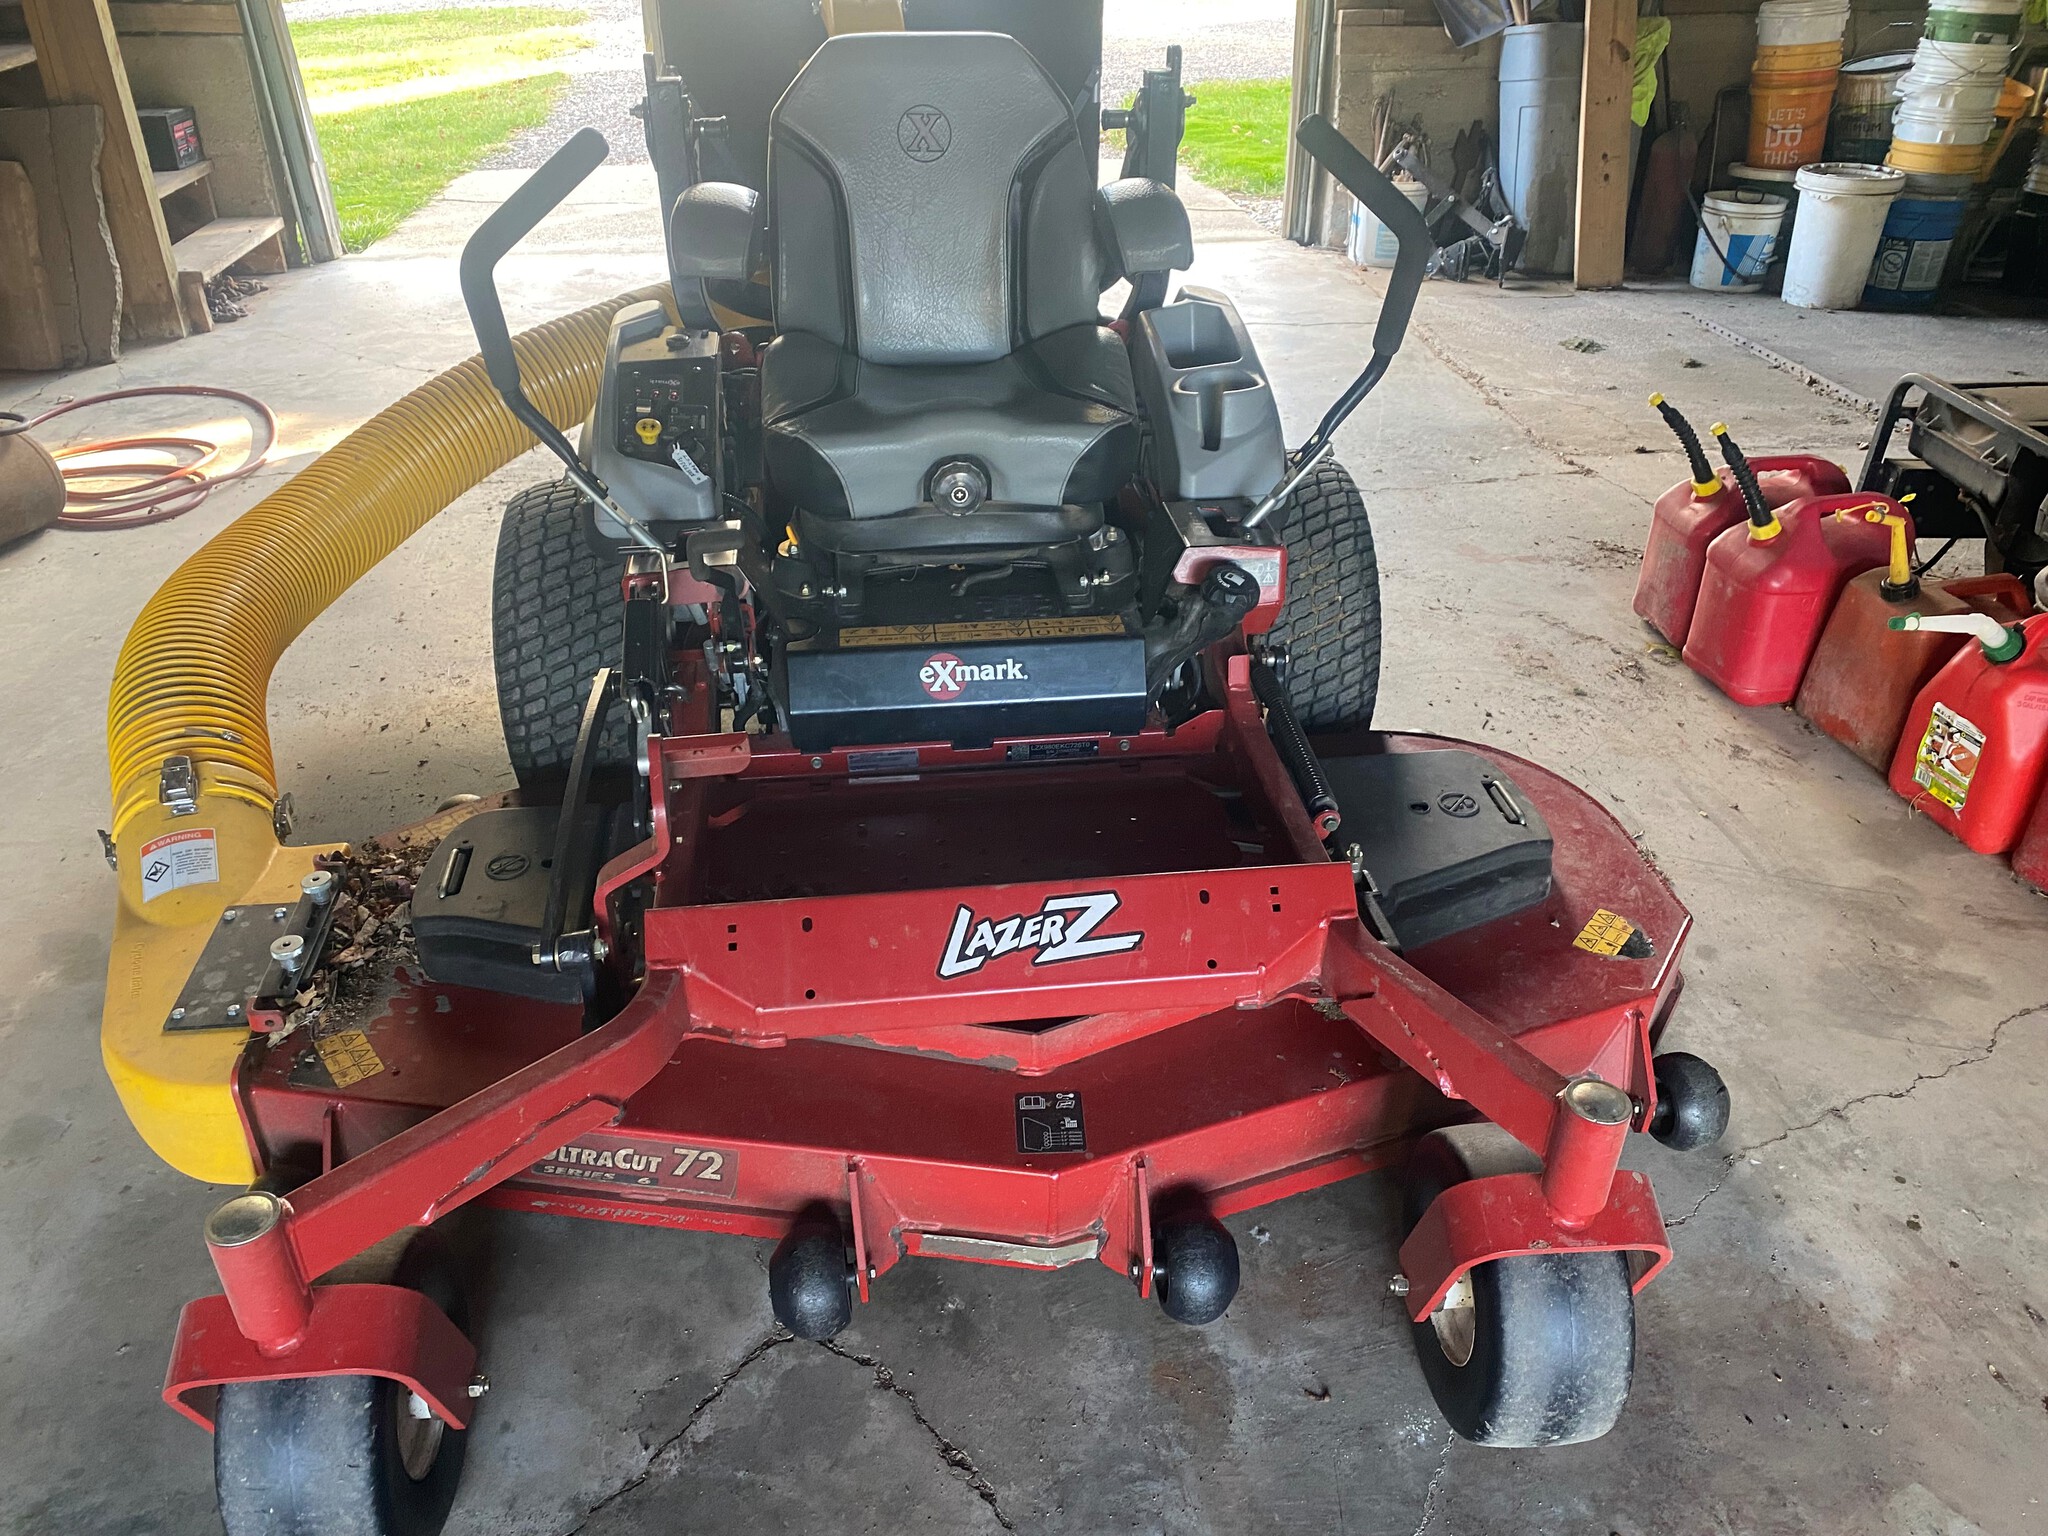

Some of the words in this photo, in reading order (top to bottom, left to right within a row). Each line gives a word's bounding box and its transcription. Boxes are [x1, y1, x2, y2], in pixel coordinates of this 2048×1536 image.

[1768, 108, 1806, 121] LET'S
[157, 831, 202, 848] WARNING
[543, 1164, 616, 1181] SERIES
[672, 1147, 724, 1181] 72
